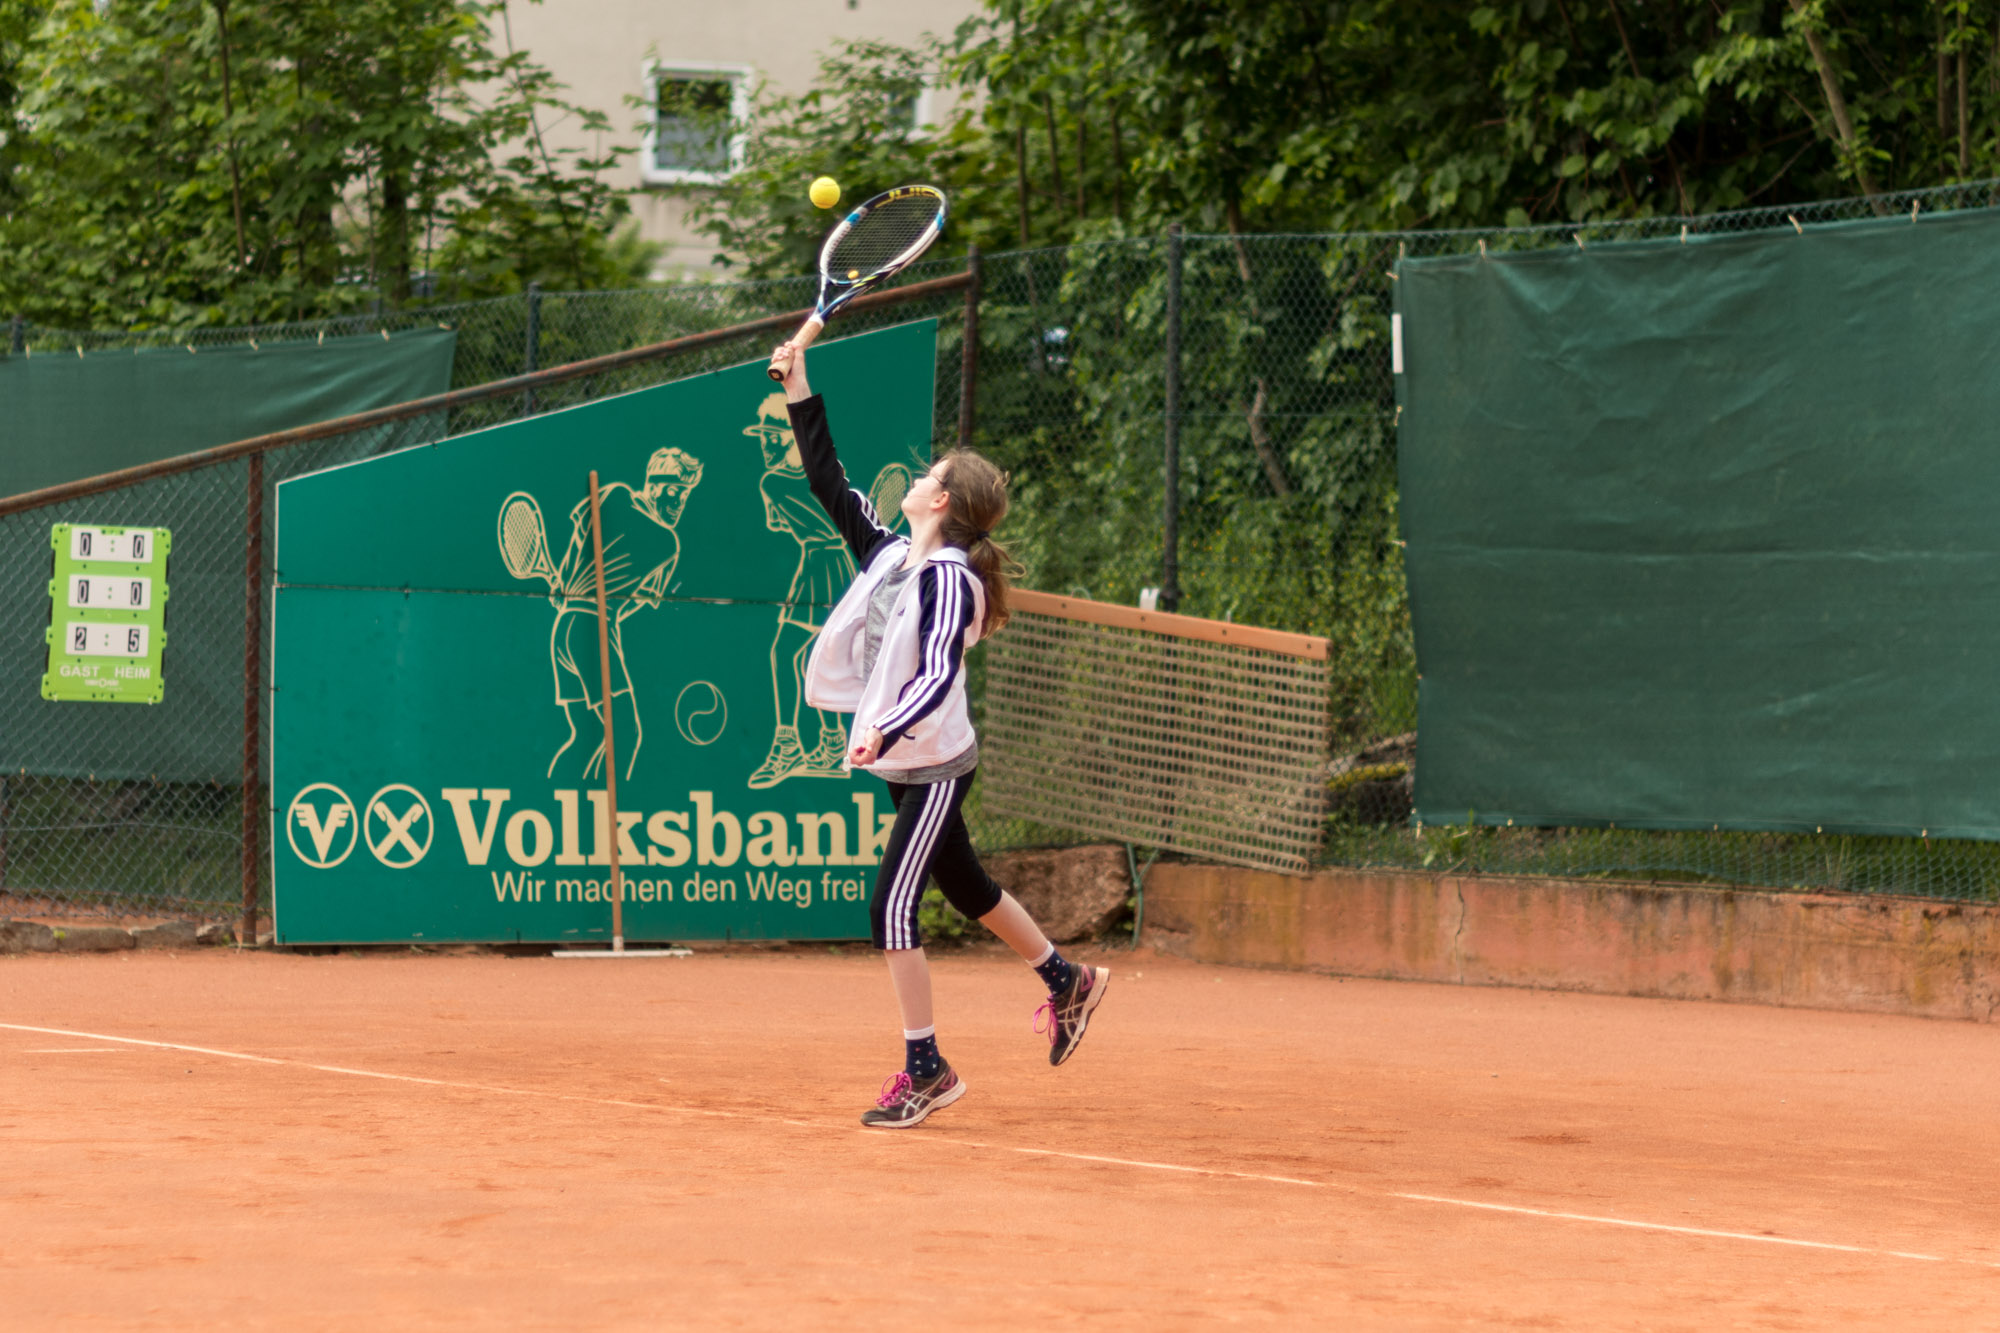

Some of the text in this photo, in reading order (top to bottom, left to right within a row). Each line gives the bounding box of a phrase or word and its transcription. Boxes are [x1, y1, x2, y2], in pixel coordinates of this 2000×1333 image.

[75, 628, 86, 650] 2
[128, 630, 139, 651] 5
[59, 665, 151, 679] GAST HEIM
[441, 788, 898, 867] Volksbank
[491, 871, 866, 909] Wir machen den Weg frei
